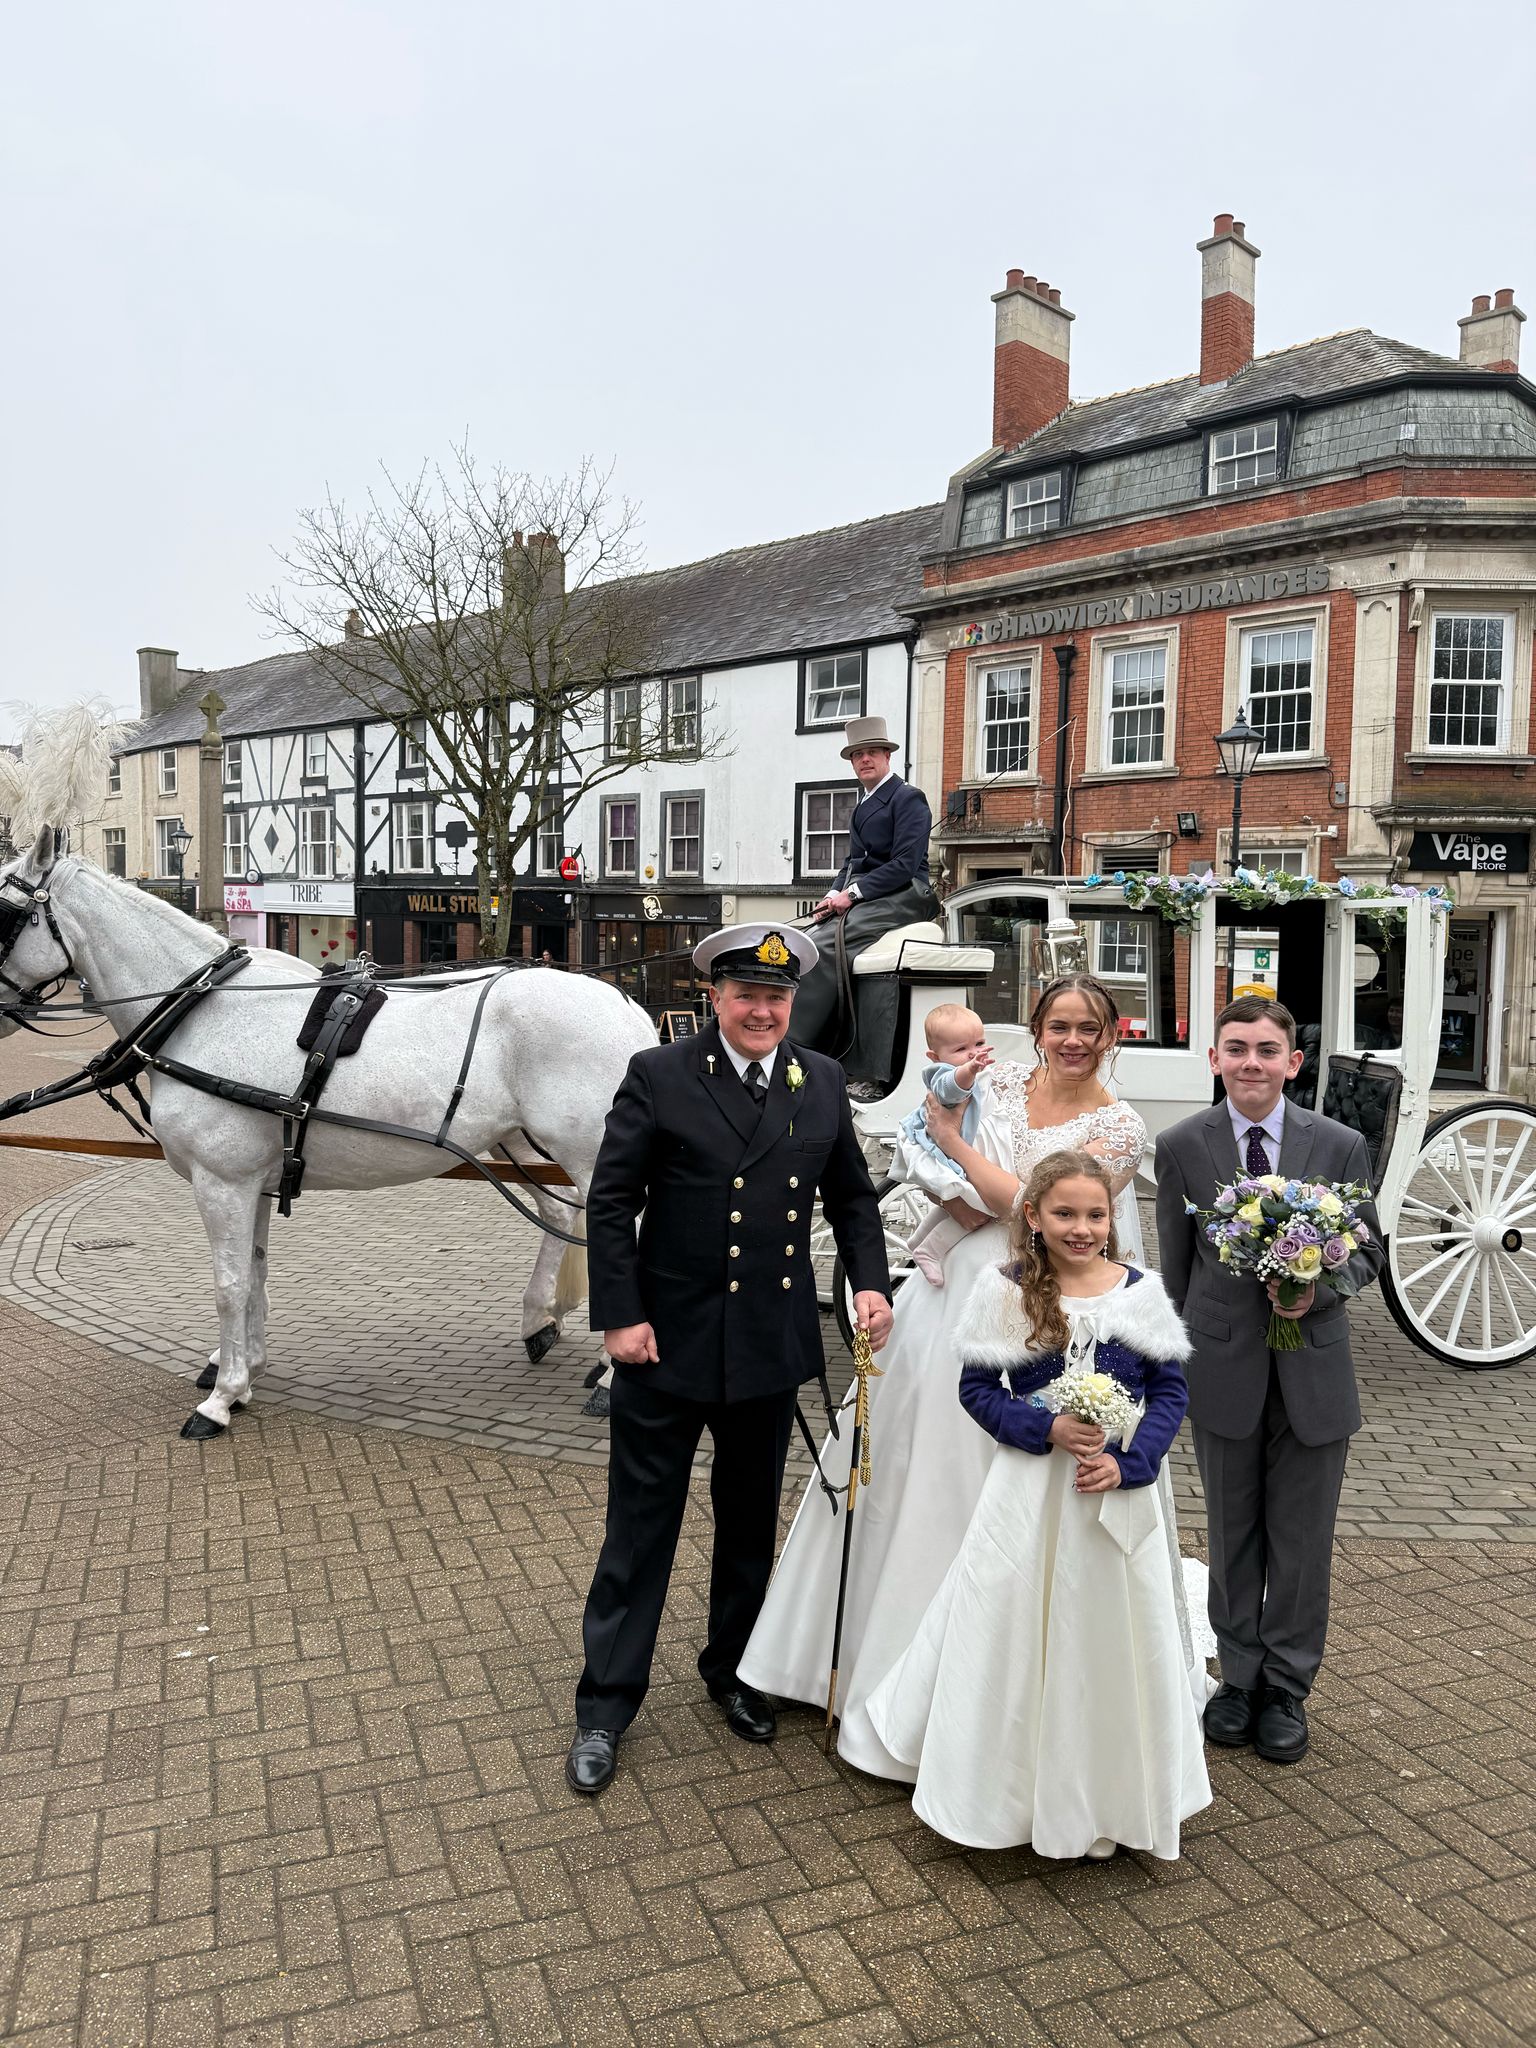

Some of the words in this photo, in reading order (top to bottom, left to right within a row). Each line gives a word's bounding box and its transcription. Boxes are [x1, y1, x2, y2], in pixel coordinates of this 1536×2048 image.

[984, 597, 1128, 642] CHADWICK
[1132, 565, 1331, 620] INSURANCES
[1459, 833, 1481, 844] The
[1431, 833, 1507, 870] Vape
[1477, 861, 1507, 871] store
[290, 884, 323, 903] TRIBE
[237, 898, 252, 910] SPA
[407, 895, 447, 912] WALL
[449, 895, 481, 914] STR
